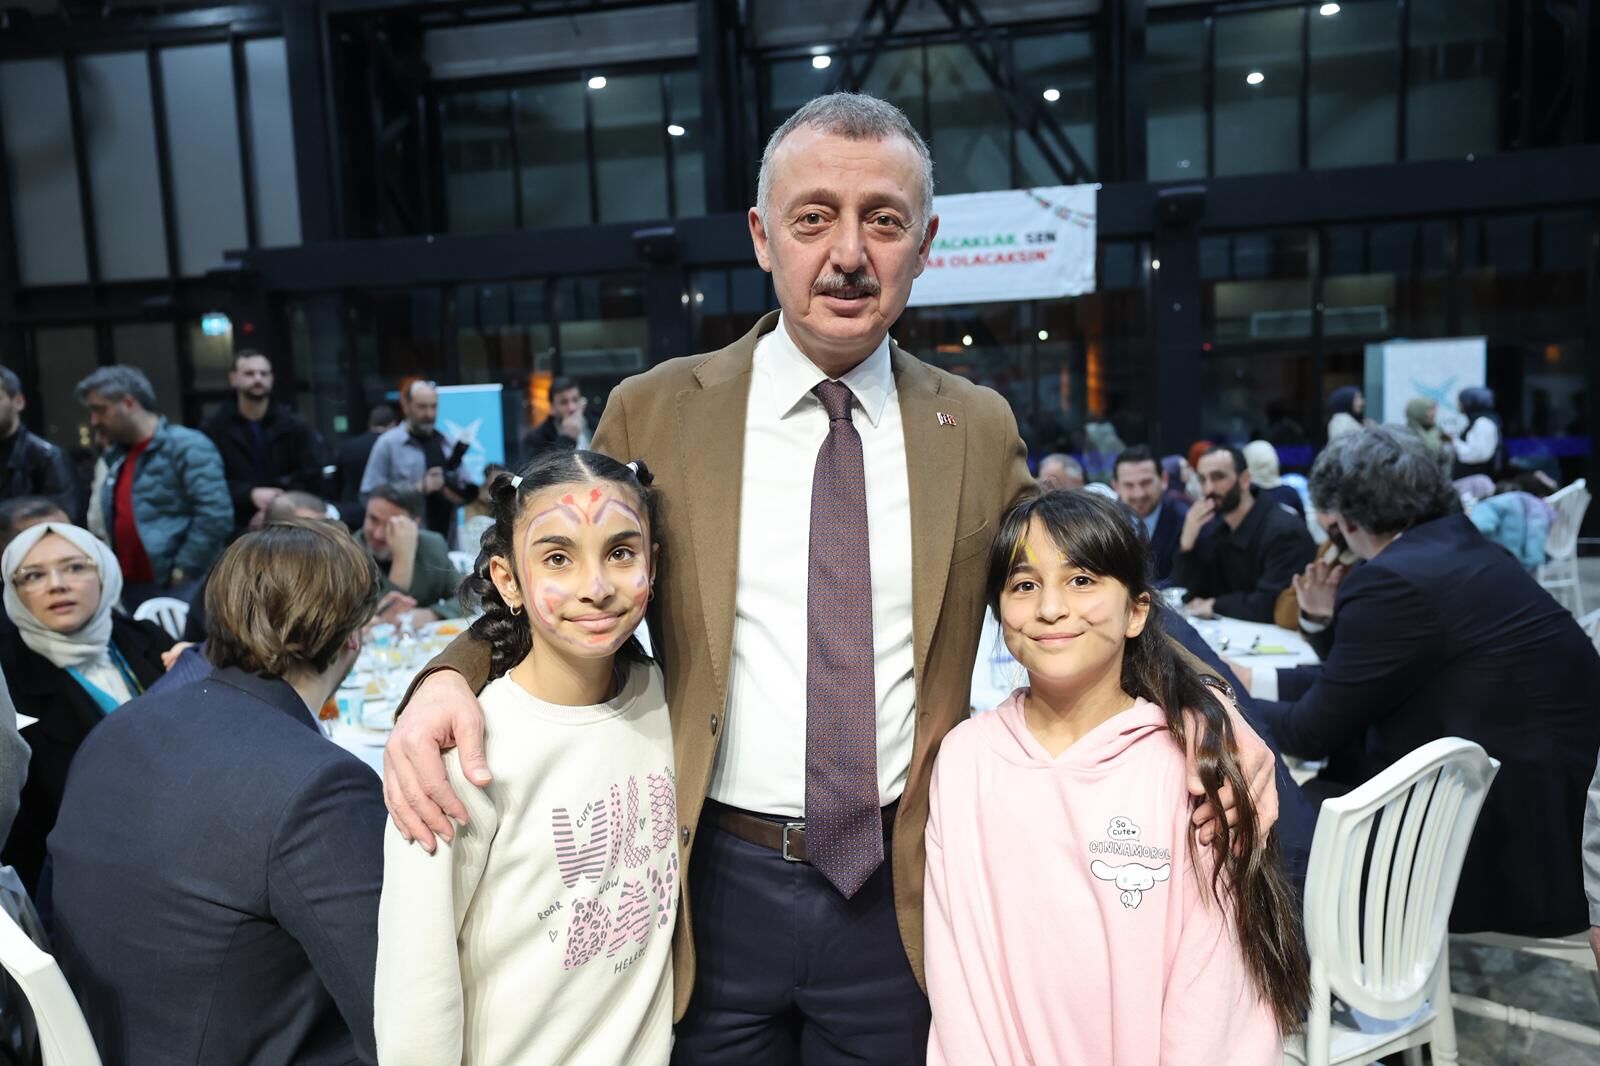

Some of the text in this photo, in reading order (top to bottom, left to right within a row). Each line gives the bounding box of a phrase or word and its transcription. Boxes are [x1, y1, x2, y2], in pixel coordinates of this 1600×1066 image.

[1025, 230, 1057, 245] SEN
[576, 801, 594, 829] CUTE
[551, 772, 676, 889] WILD
[537, 900, 564, 921] ROAR
